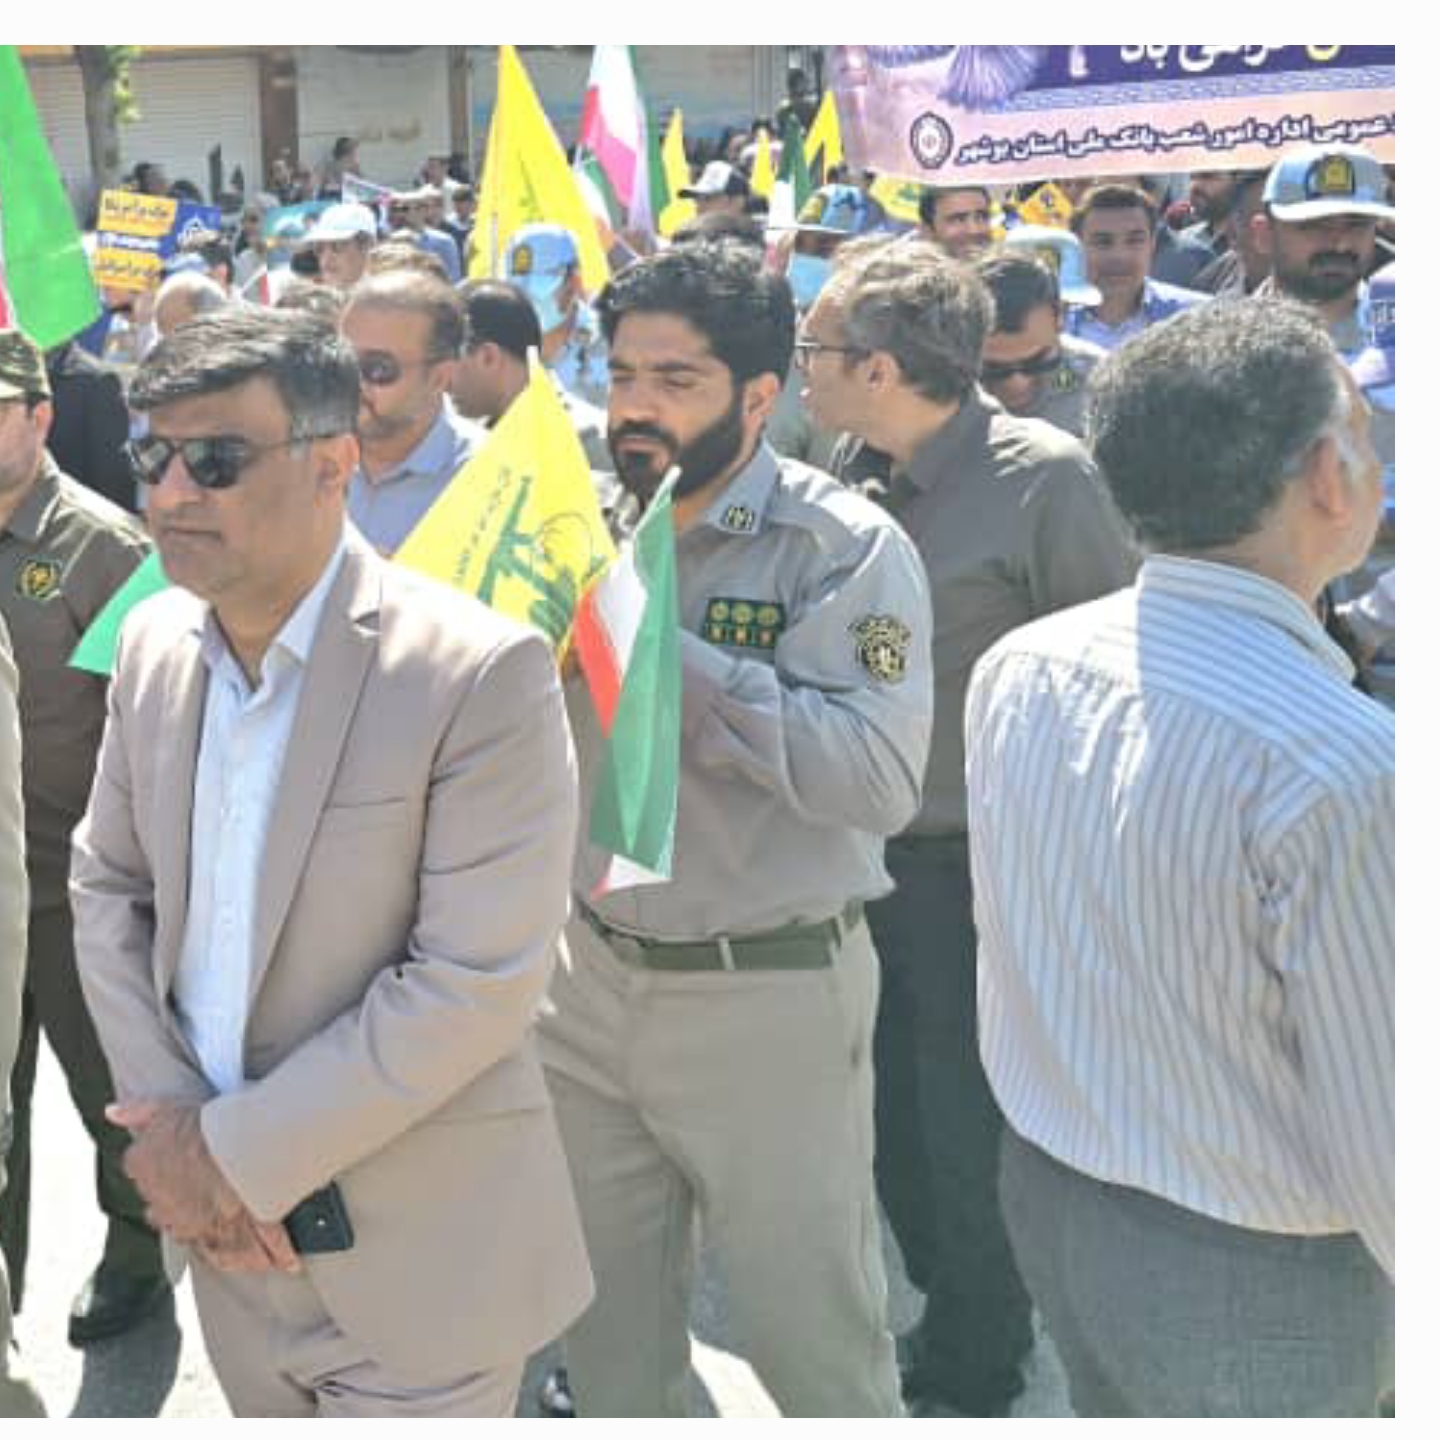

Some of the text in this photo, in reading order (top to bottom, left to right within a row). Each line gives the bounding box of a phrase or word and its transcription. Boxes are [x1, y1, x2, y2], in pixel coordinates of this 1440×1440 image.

[1066, 125, 1106, 157] ملی
[1110, 123, 1157, 152] بانک
[1158, 121, 1209, 151] شعب
[1209, 117, 1256, 149] امور
[1257, 114, 1312, 147] اداره
[1313, 114, 1390, 143] عمومی
[954, 134, 1011, 166] بوشهر
[1012, 129, 1066, 160] استان
